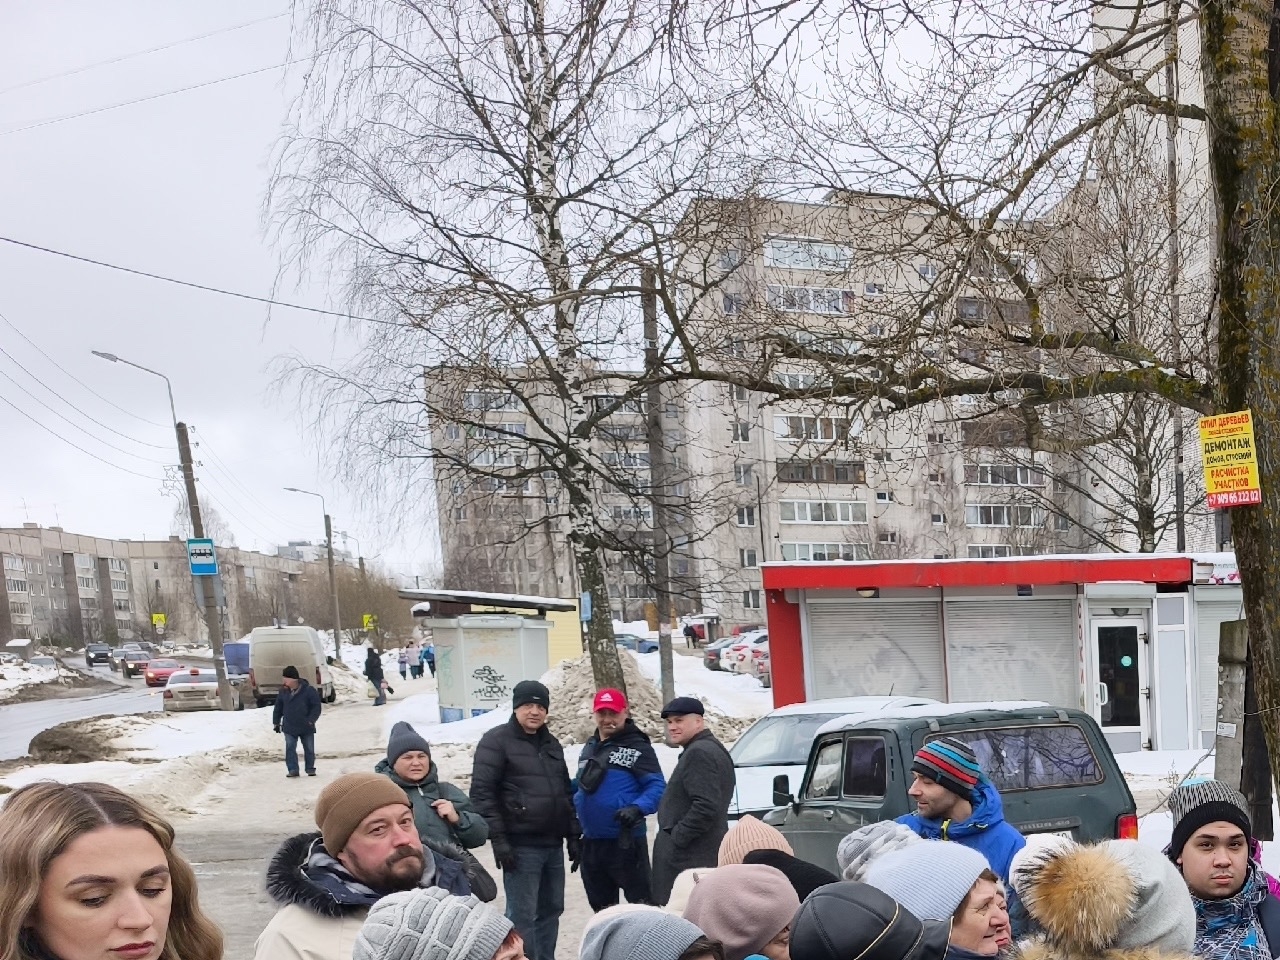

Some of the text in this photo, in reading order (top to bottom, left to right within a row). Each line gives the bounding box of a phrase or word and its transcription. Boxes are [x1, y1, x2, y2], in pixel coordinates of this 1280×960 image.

[1200, 414, 1249, 429] СПИЛ ДЕРЕВЬЕВ
[1204, 438, 1251, 455] ДЕМОНТАЖ
[1226, 450, 1252, 462] СТРОЕНИЙ
[1210, 466, 1250, 479] РАСЧИСТКА
[1213, 477, 1249, 490] УЧАСТКОВ
[1208, 495, 1216, 504] +7
[1217, 493, 1228, 504] 909
[1250, 490, 1258, 501] 02
[618, 746, 636, 755] THE
[608, 757, 632, 768] FACE
